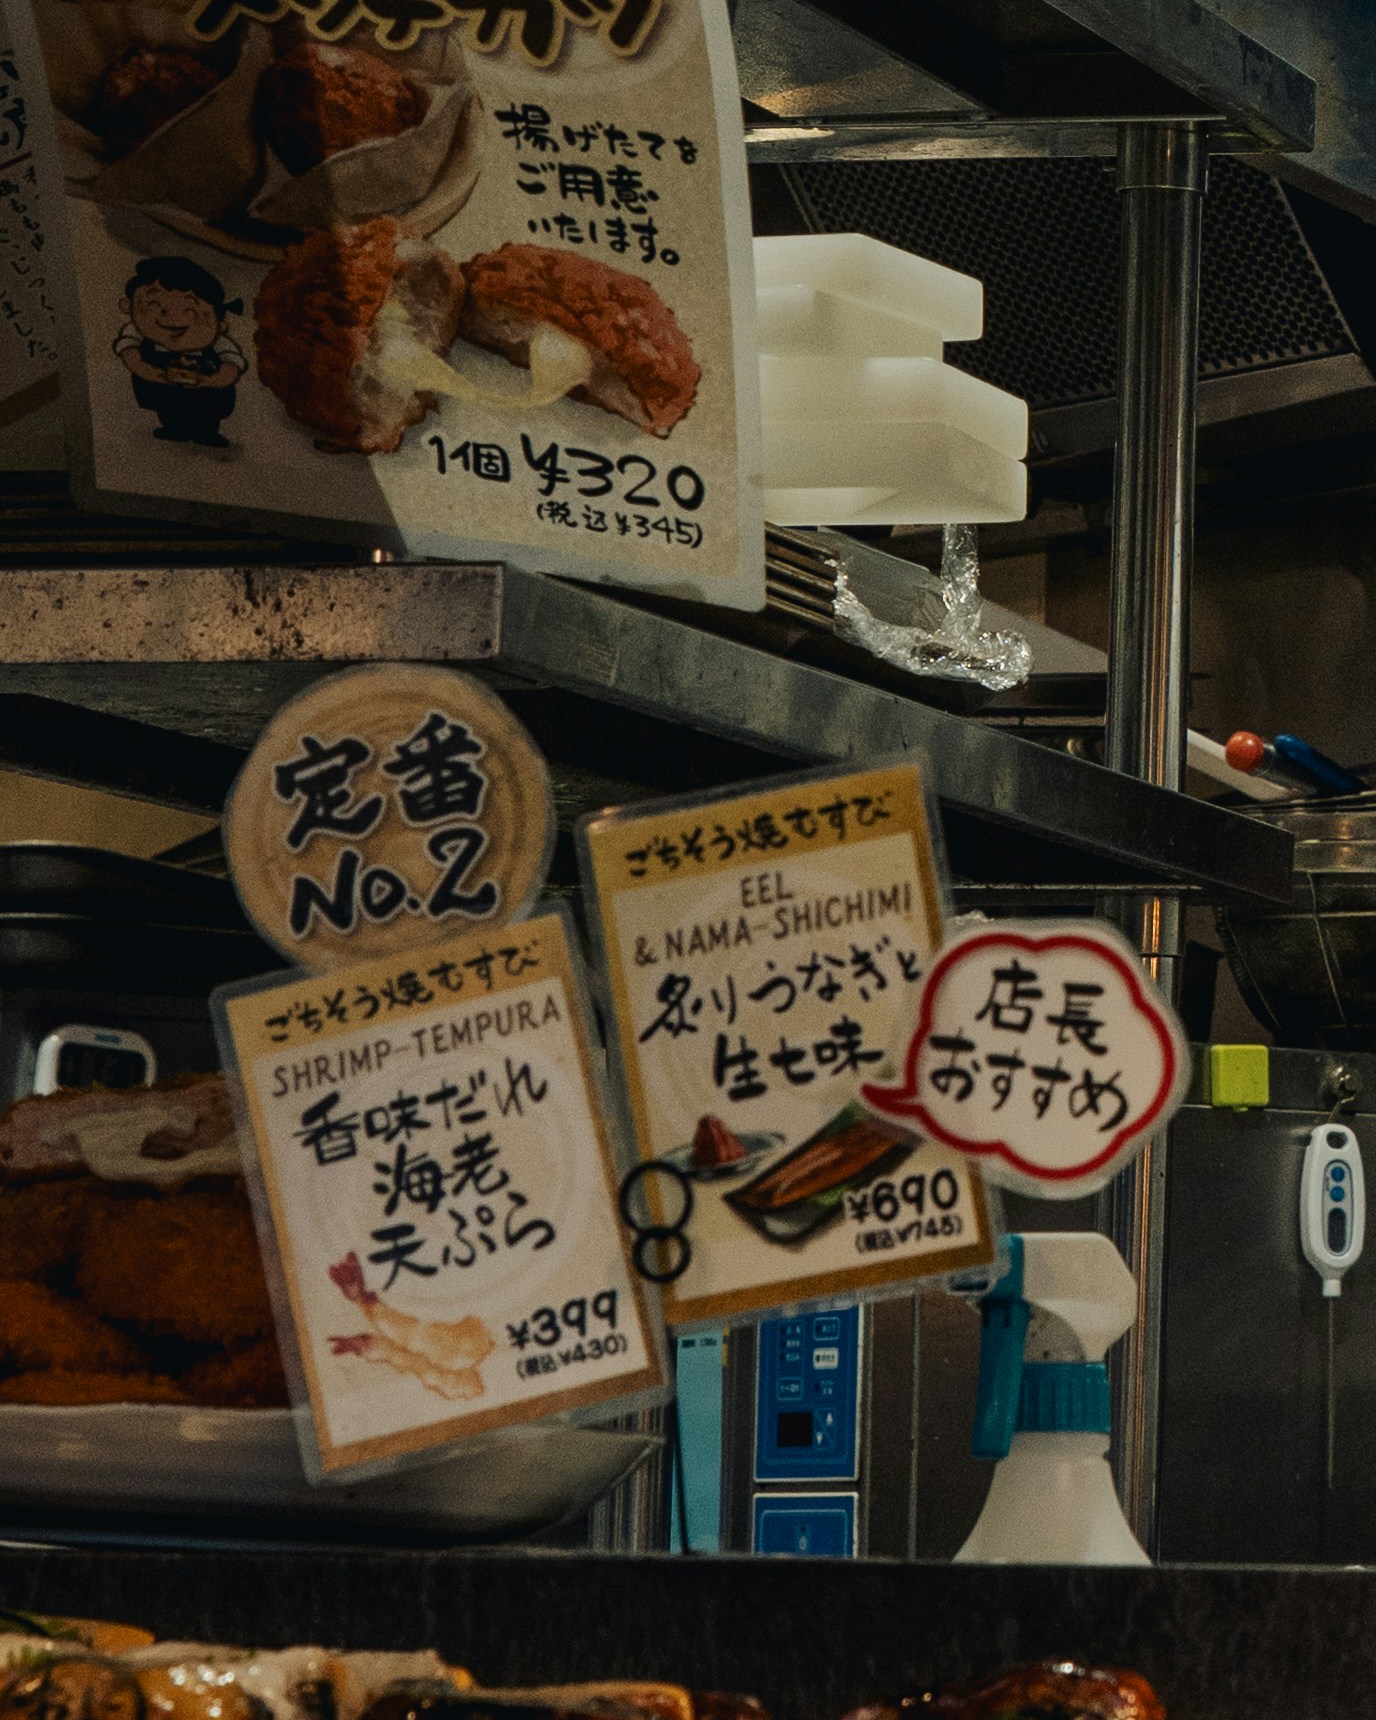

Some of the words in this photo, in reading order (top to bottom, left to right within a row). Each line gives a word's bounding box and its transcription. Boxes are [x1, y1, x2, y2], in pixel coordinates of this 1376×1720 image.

[494, 102, 699, 165] 揚げたてを
[516, 161, 661, 216] ご用意
[527, 210, 681, 267] いたします。
[428, 434, 511, 483] 1個
[520, 432, 706, 511] ¥320
[274, 712, 488, 849] 定番
[634, 936, 659, 967] &
[664, 882, 913, 960] NAMA-SHICHIMI
[740, 872, 794, 909] EEL
[637, 935, 922, 1044] 炙りうなぎと
[976, 958, 1109, 1056] 店長
[271, 993, 563, 1099] SHRIMP-TEMPURA
[712, 1015, 884, 1102] 生七味
[928, 1027, 1130, 1133] おすすめ
[293, 1056, 549, 1167] 香味だれ
[373, 1131, 511, 1217] 海老
[847, 1167, 961, 1222] ¥690
[368, 1191, 557, 1292] 天ぷら
[505, 1288, 620, 1352] ¥399
